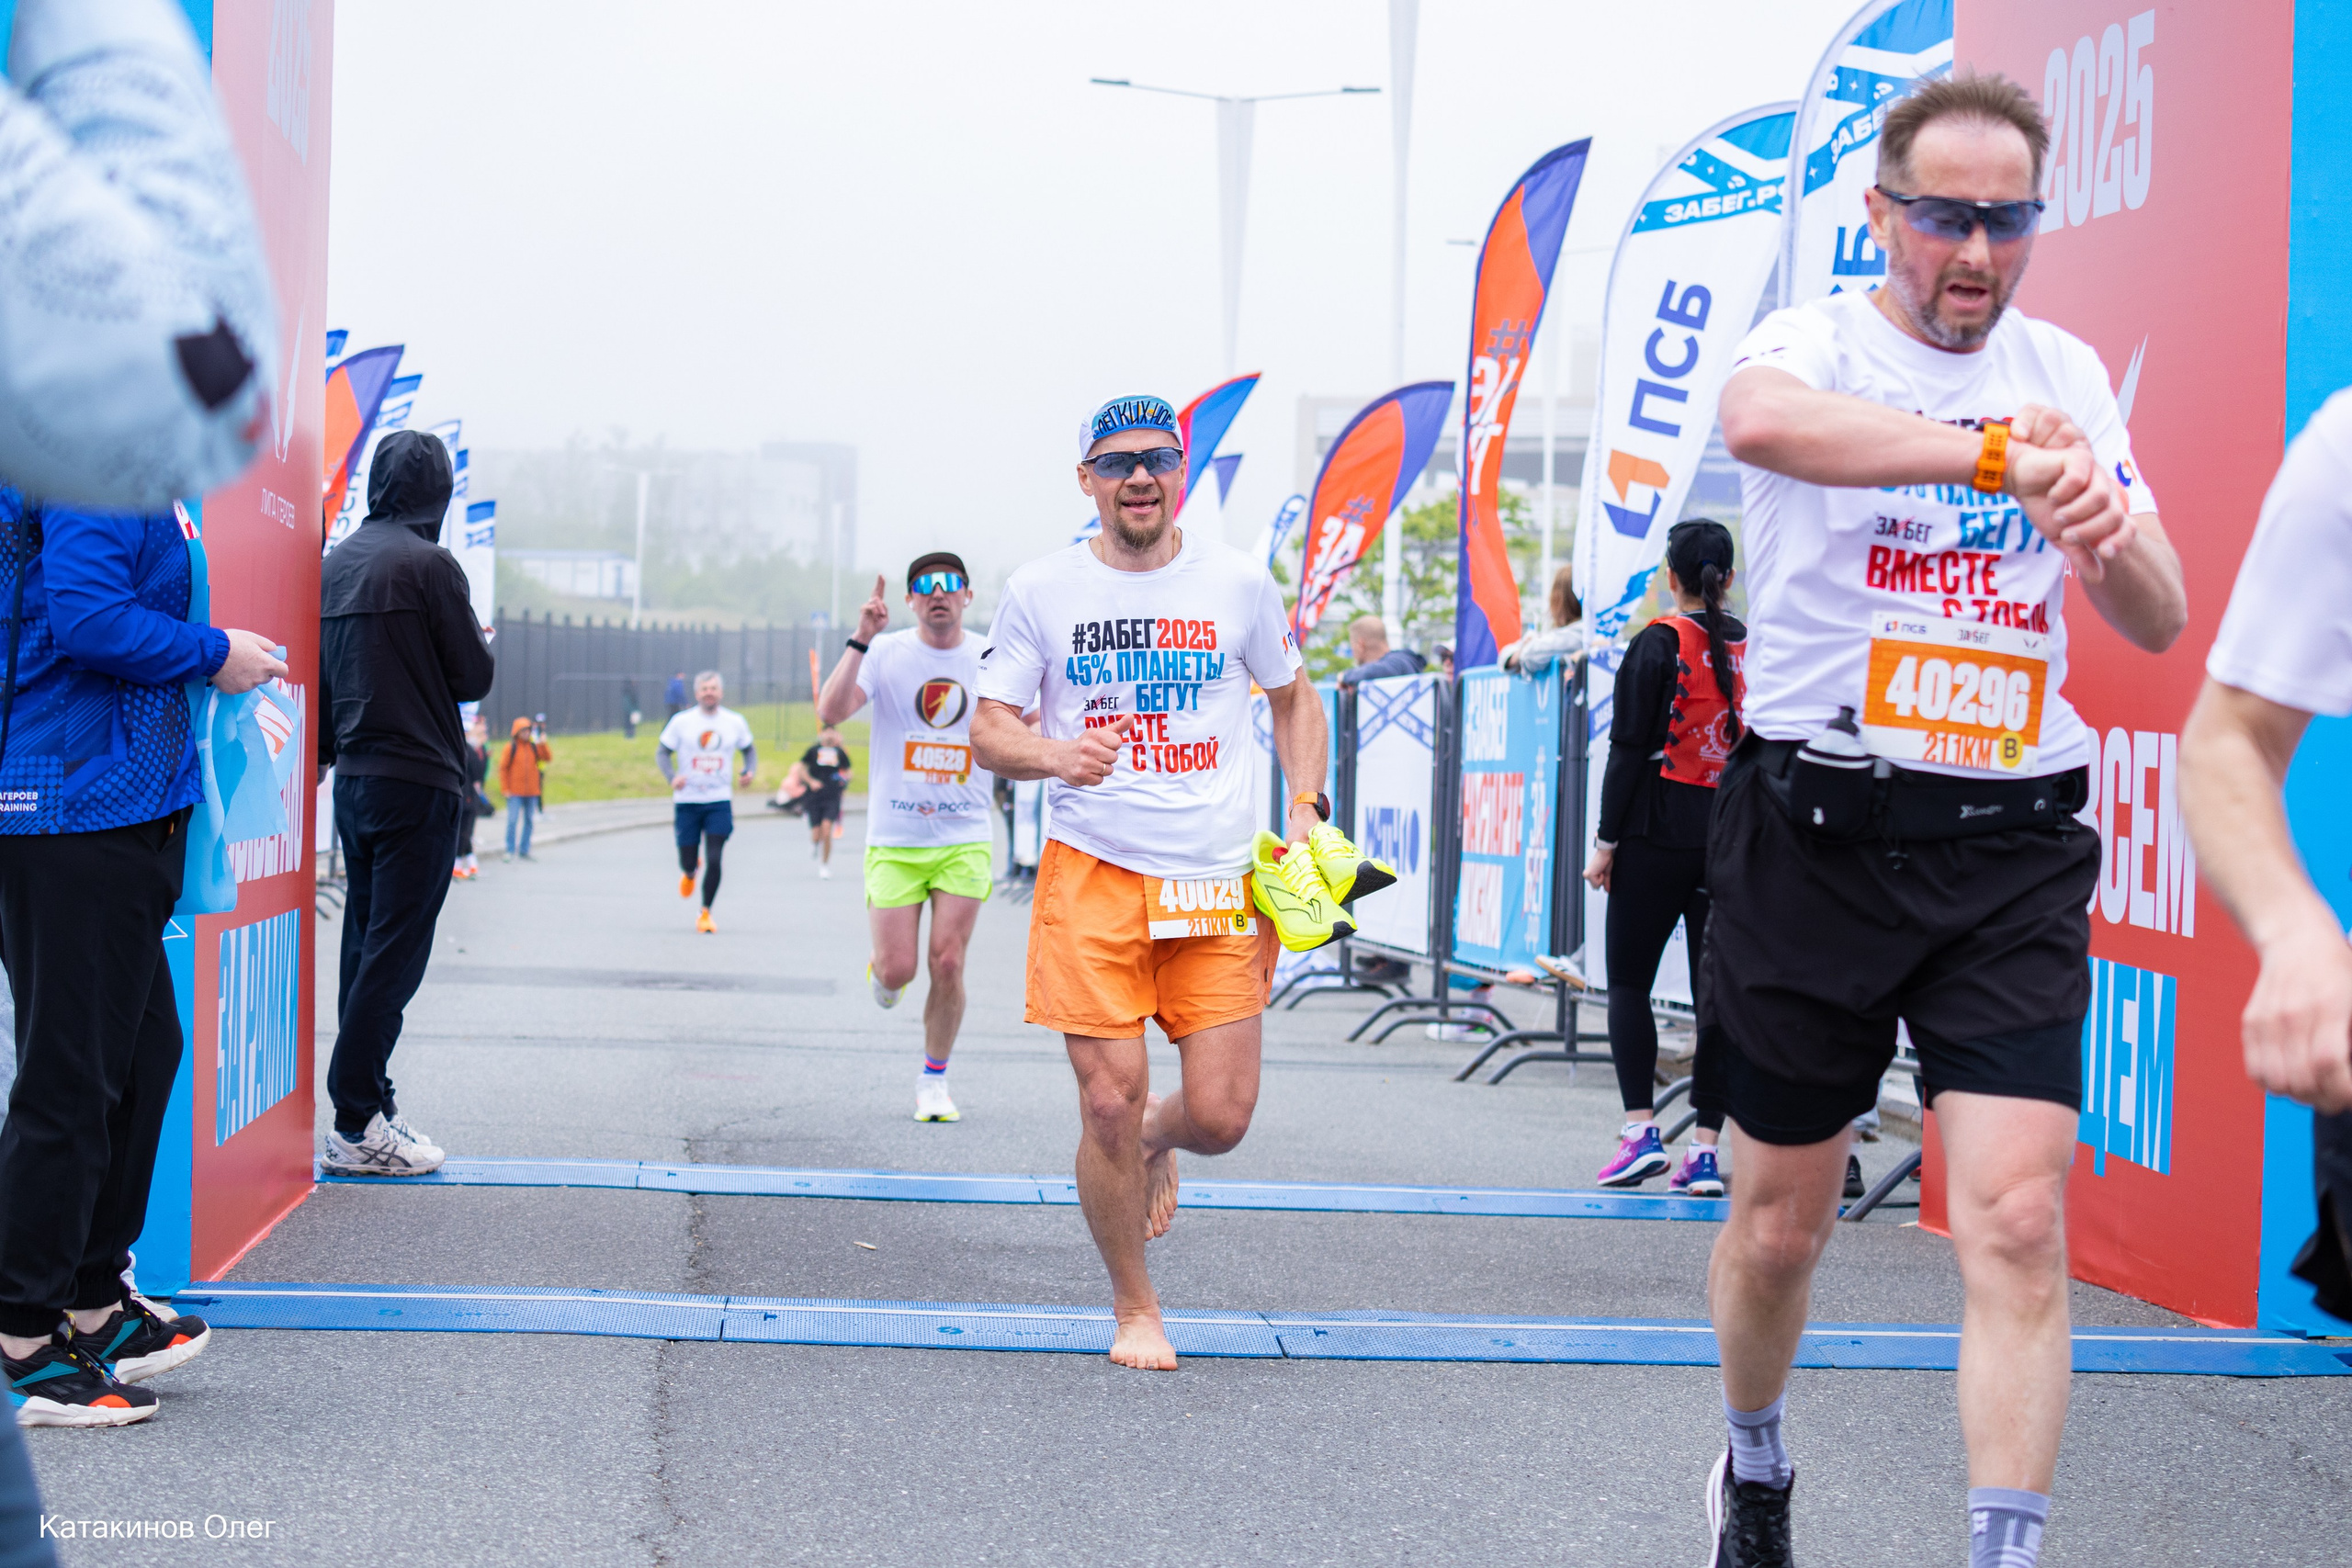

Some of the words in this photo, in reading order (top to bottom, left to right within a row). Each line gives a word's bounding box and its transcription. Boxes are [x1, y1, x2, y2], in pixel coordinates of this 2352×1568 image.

[2038, 8, 2155, 236] 2025
[1628, 280, 1712, 438] ПСБ
[1866, 544, 2002, 596] ВМЕСТЕ
[1066, 653, 1112, 686] 45%
[1116, 650, 1225, 682] ПЛАНЕТЫ
[1136, 682, 1204, 713] БЕГУТ
[1884, 655, 2032, 732] 40296
[910, 745, 967, 772] 40528
[1132, 743, 1147, 772] С
[1150, 736, 1219, 773] ТОБОЙ
[1159, 876, 1246, 913] 40029
